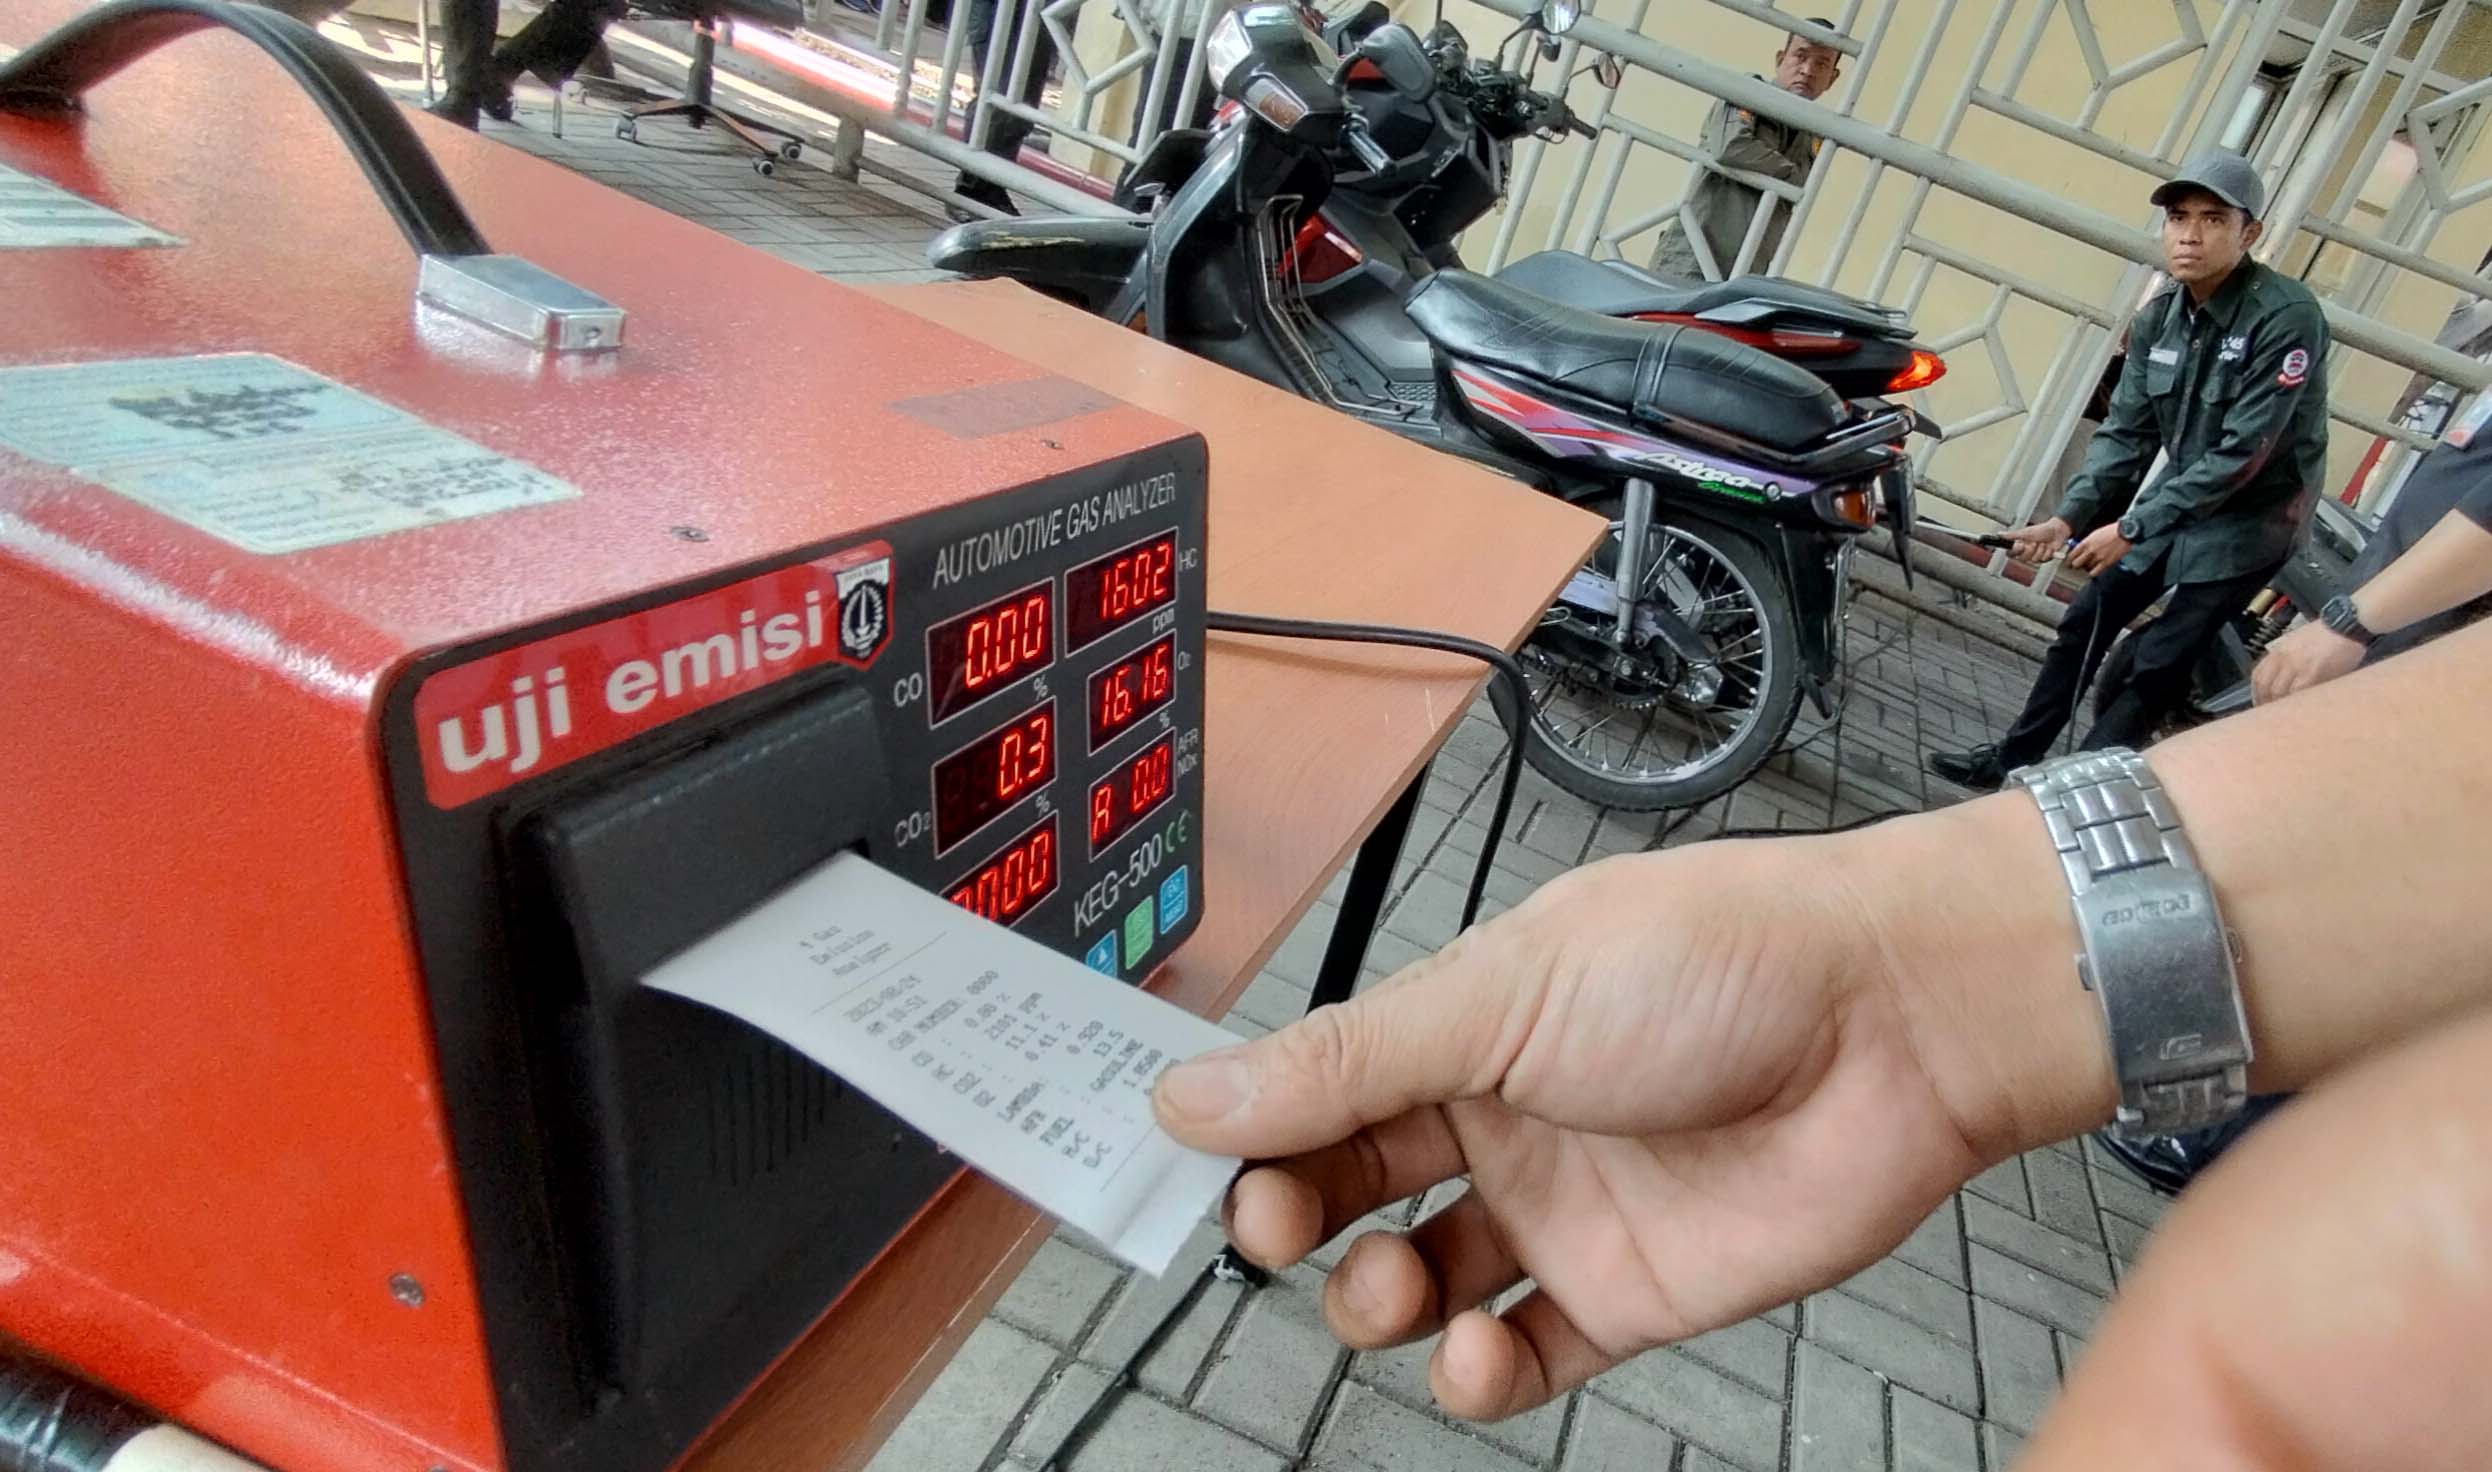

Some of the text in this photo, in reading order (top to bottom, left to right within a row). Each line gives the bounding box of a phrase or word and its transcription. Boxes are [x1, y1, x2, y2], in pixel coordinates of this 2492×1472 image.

[933, 472, 1176, 590] AUTOMOTIVE GAS ANALYZER
[1102, 542, 1170, 619] 1602
[1179, 547, 1198, 572] HC
[964, 596, 1045, 689] 0.00
[1152, 607, 1175, 634] ppm
[438, 590, 824, 774] uji emisi
[894, 672, 923, 708] CO
[1032, 676, 1049, 700] %
[999, 715, 1048, 798] 0.3
[1178, 728, 1199, 755] AFR
[1035, 792, 1050, 817] %
[1074, 833, 1163, 938] KEG-500
